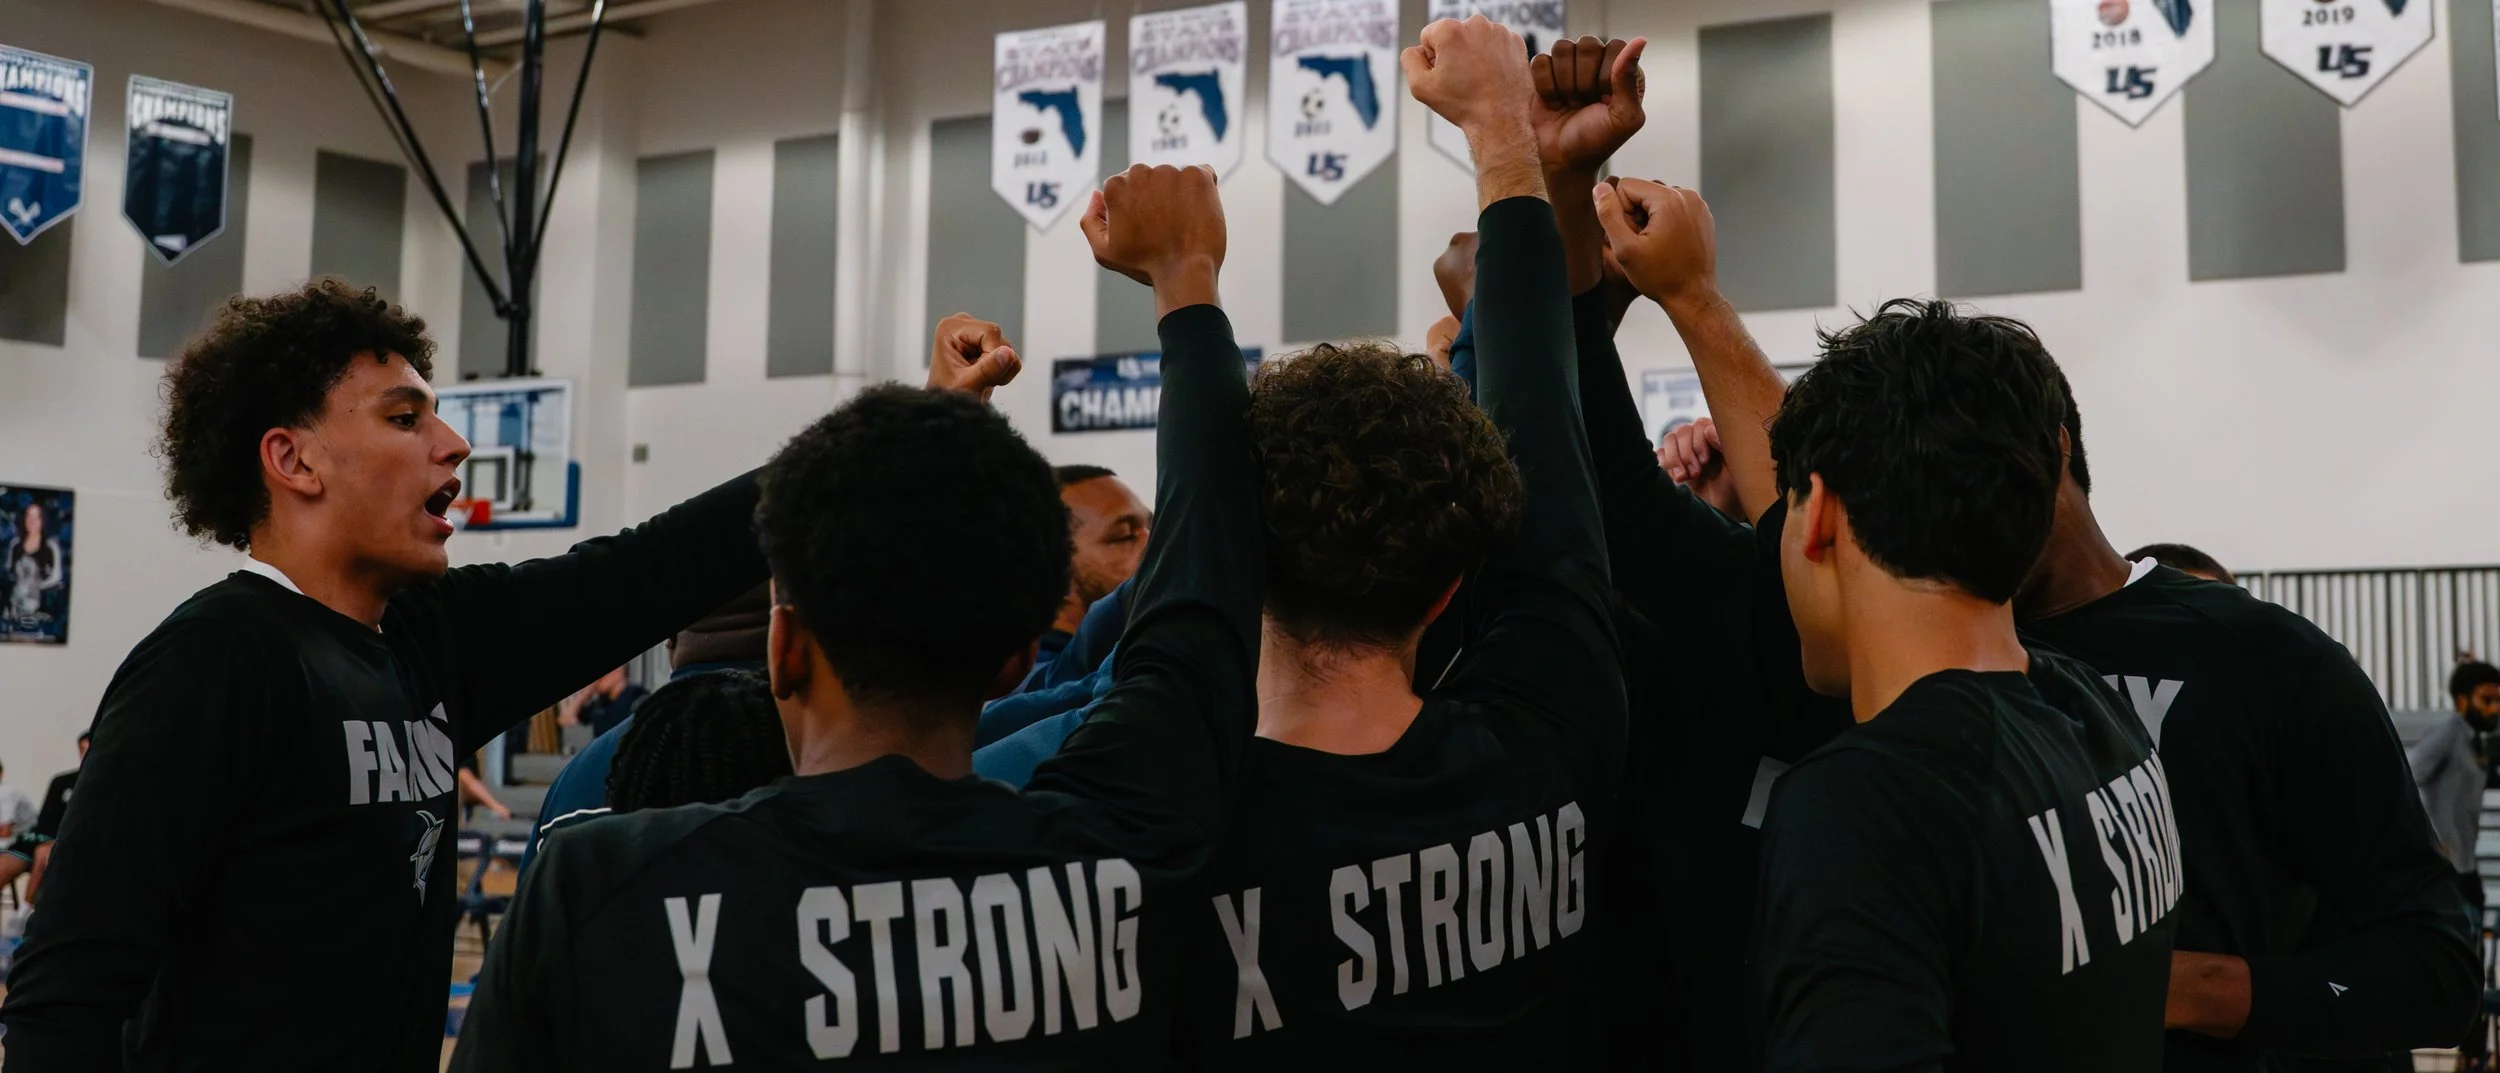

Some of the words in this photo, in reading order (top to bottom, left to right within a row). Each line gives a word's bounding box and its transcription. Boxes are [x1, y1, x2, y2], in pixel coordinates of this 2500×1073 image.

[2302, 4, 2355, 27] 2019
[2092, 28, 2141, 50] 2018
[2318, 45, 2372, 79] US
[2106, 66, 2157, 100] US
[2027, 808, 2090, 975] X
[2085, 747, 2183, 945] STRON
[1212, 887, 1283, 1040] X
[1329, 801, 1585, 1011] STRONG
[664, 893, 733, 1069] X
[797, 858, 1142, 1060] STRONG
